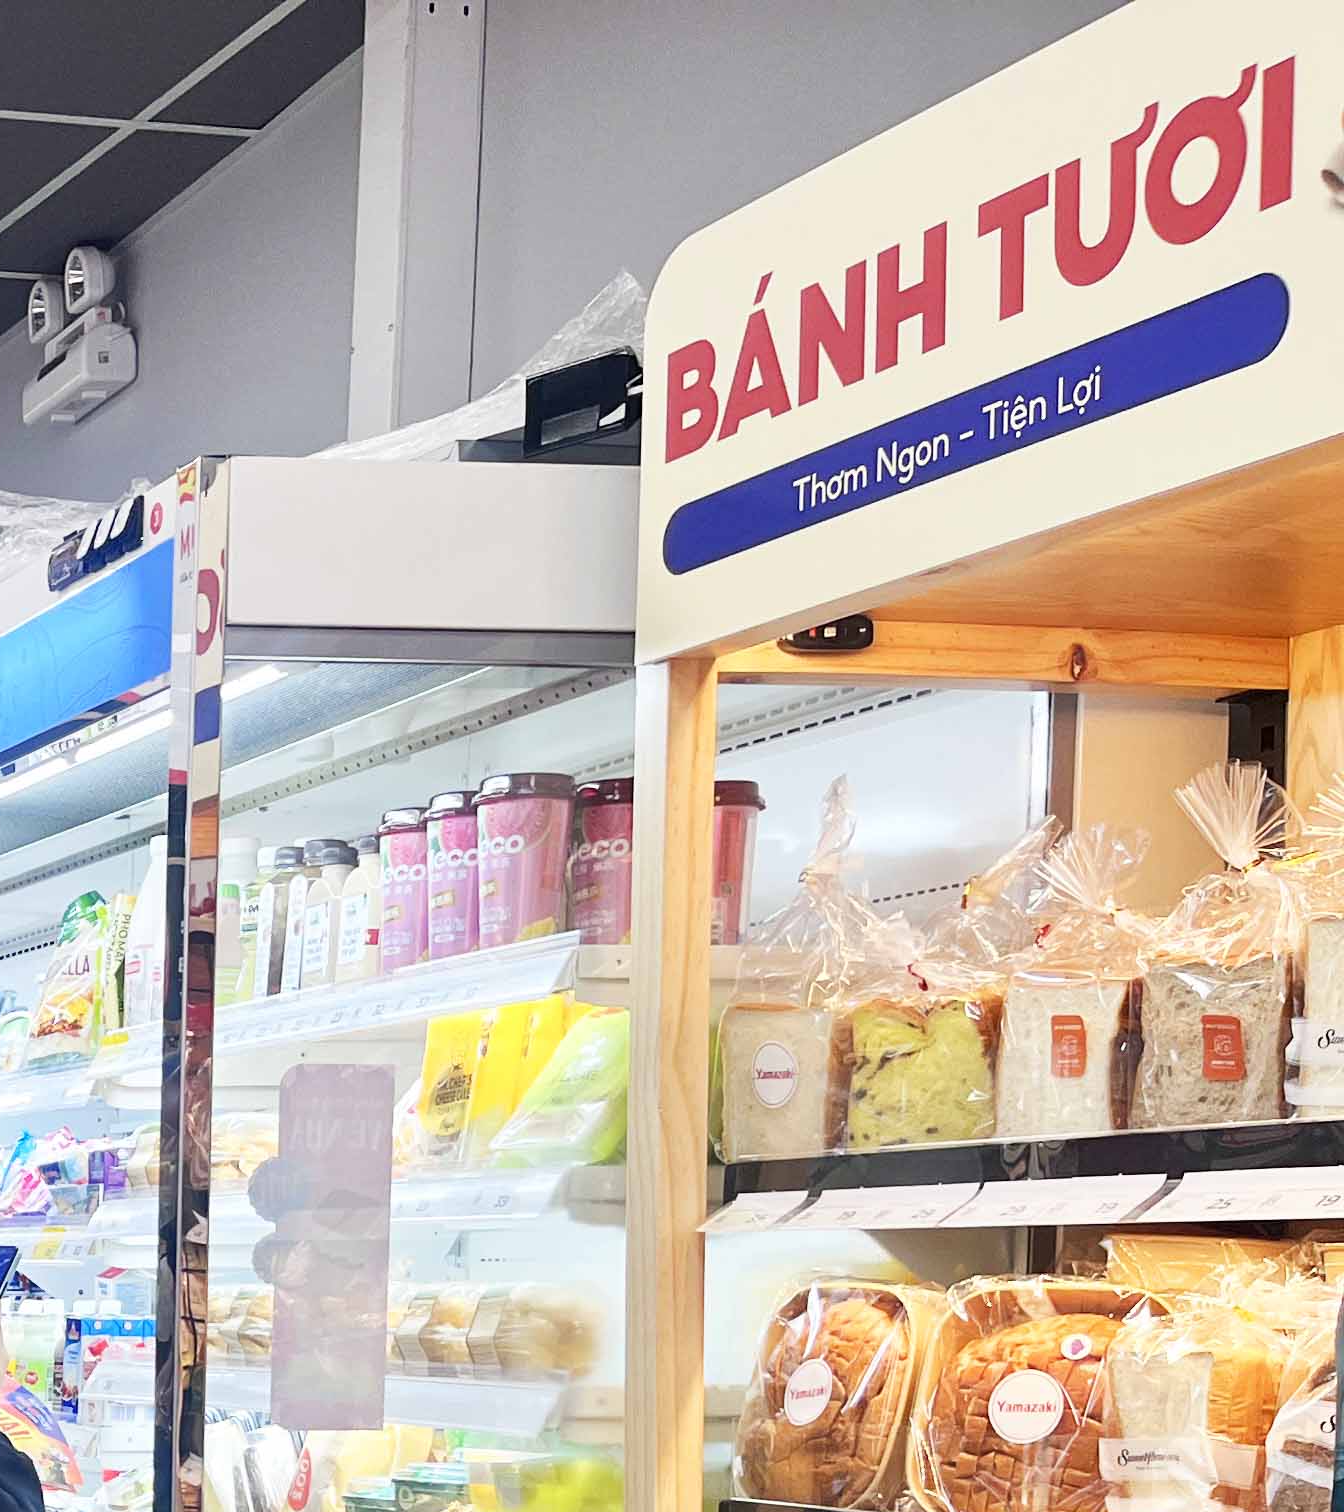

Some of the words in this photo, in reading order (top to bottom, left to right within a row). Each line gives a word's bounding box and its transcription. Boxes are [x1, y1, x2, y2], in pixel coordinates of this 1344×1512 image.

[665, 271, 948, 463] BÁNH
[977, 55, 1295, 321] TƯƠI
[793, 461, 868, 512] Thơm
[875, 431, 951, 484] Ngon
[981, 394, 1047, 441] Tiện
[1055, 365, 1103, 419] Lợi
[755, 1067, 794, 1080] Yamazaki
[997, 1400, 1058, 1413] Yamazaki
